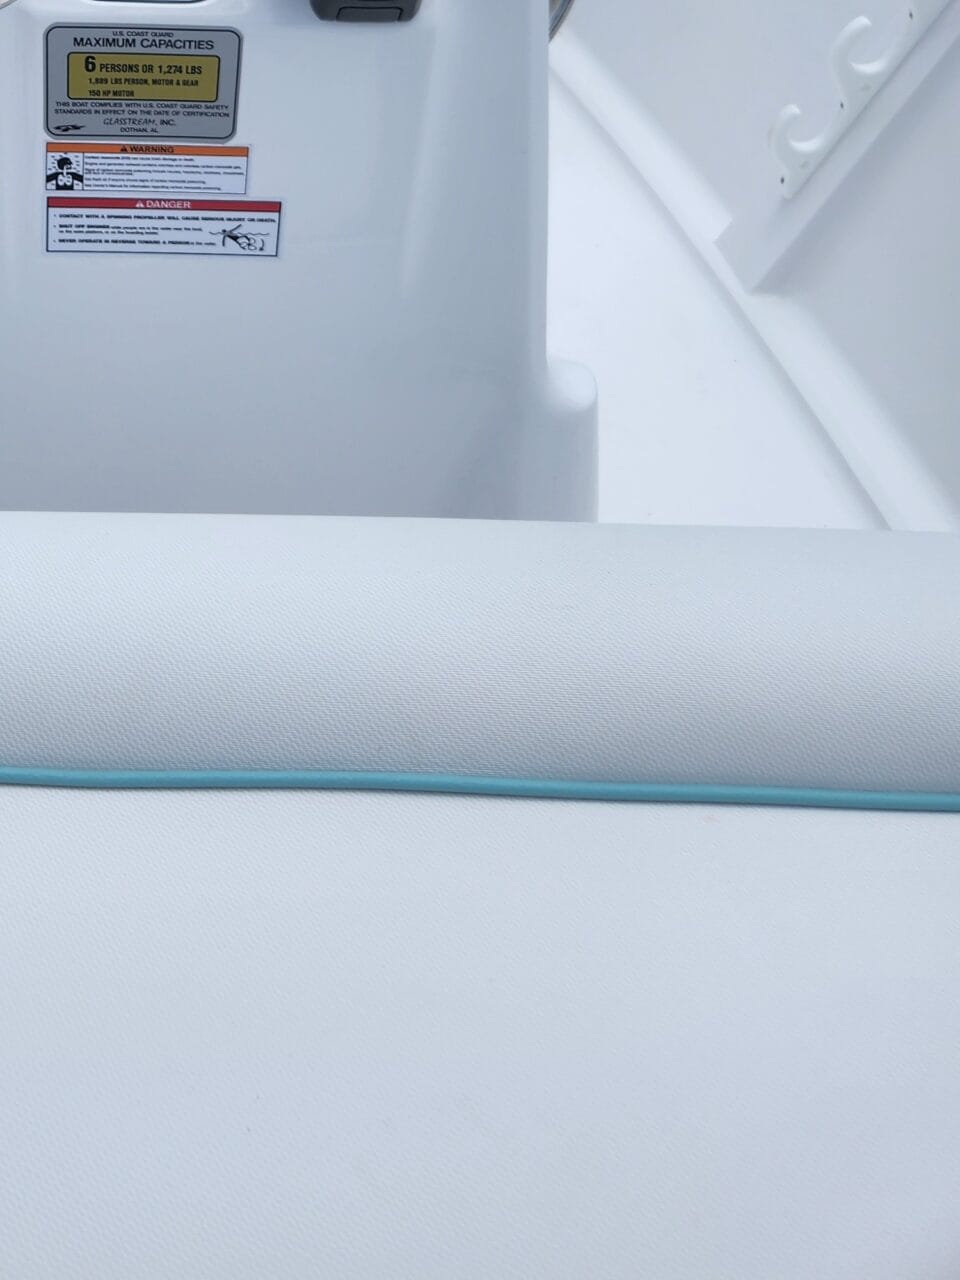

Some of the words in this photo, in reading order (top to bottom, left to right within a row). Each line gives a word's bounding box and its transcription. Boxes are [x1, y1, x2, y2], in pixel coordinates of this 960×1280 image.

[73, 37, 137, 48] MAXIMUM
[139, 38, 215, 50] CAPACITIES
[84, 55, 96, 73] 6
[99, 63, 140, 74] PERSONS
[141, 64, 154, 74] OR
[158, 65, 182, 75] 1,274
[185, 65, 203, 75] LBS
[88, 89, 101, 97] 150
[102, 89, 112, 97] HP
[130, 145, 175, 154] WARNING
[146, 200, 192, 209] DANGER
